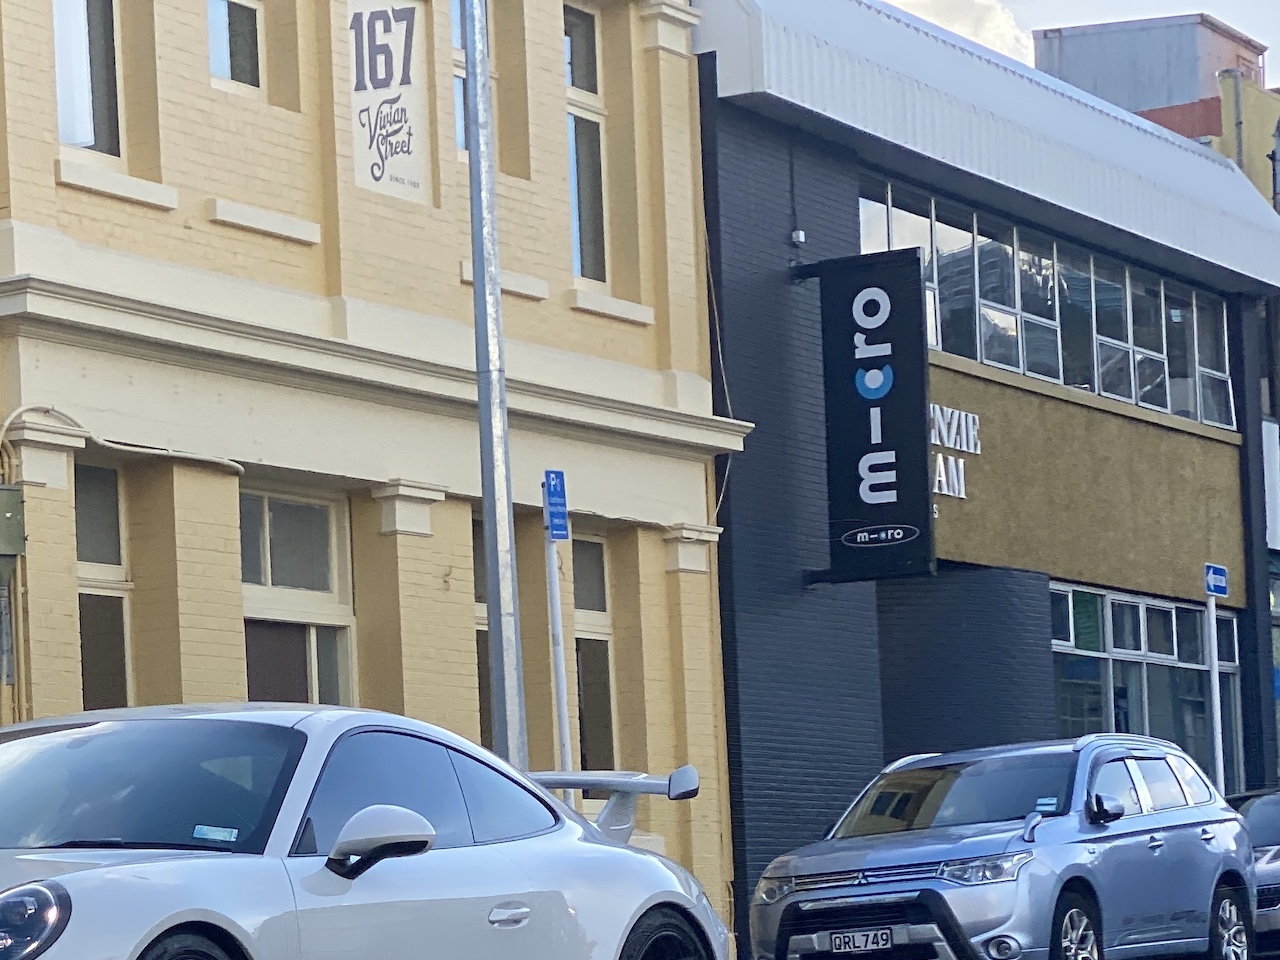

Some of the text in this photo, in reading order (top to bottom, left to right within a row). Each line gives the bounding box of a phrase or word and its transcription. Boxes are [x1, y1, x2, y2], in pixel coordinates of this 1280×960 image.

[349, 7, 416, 91] 167
[358, 93, 409, 150] Vivian
[370, 125, 414, 182] Street
